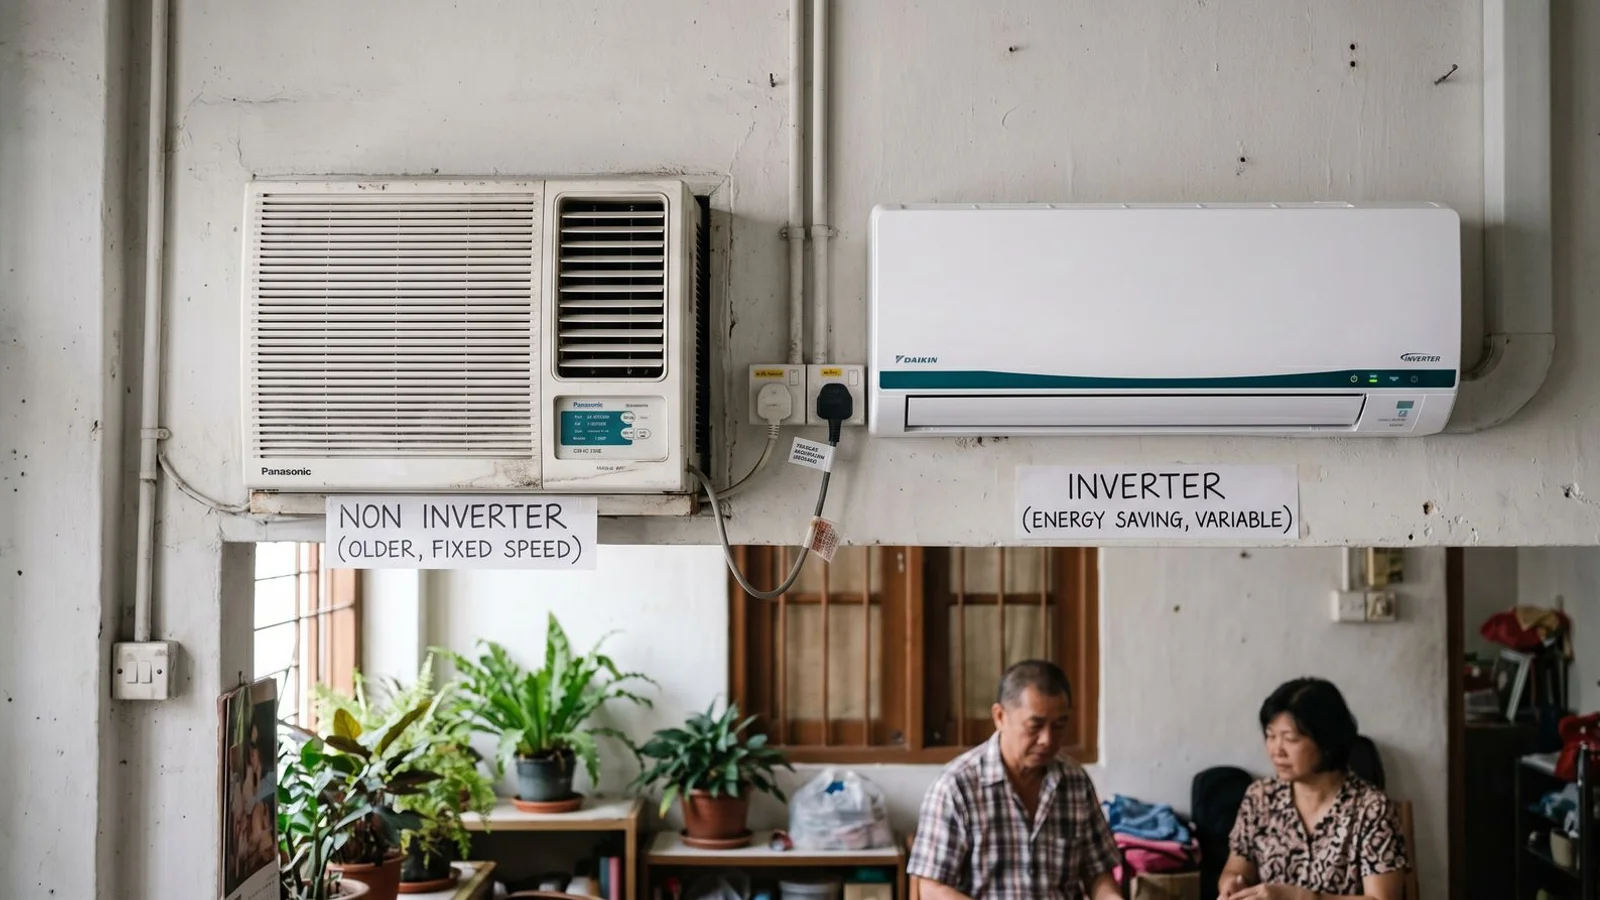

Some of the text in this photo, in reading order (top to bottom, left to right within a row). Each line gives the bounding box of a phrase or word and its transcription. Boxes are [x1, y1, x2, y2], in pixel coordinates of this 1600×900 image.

[261, 467, 312, 476] Panasonic
[1068, 472, 1225, 500] INVERTER
[340, 503, 567, 529] NON INVERTER
[1022, 505, 1293, 534] (ENERGY SAVING, VARIABLE)
[338, 535, 582, 564] (OLDER, FIXED SPEED)
